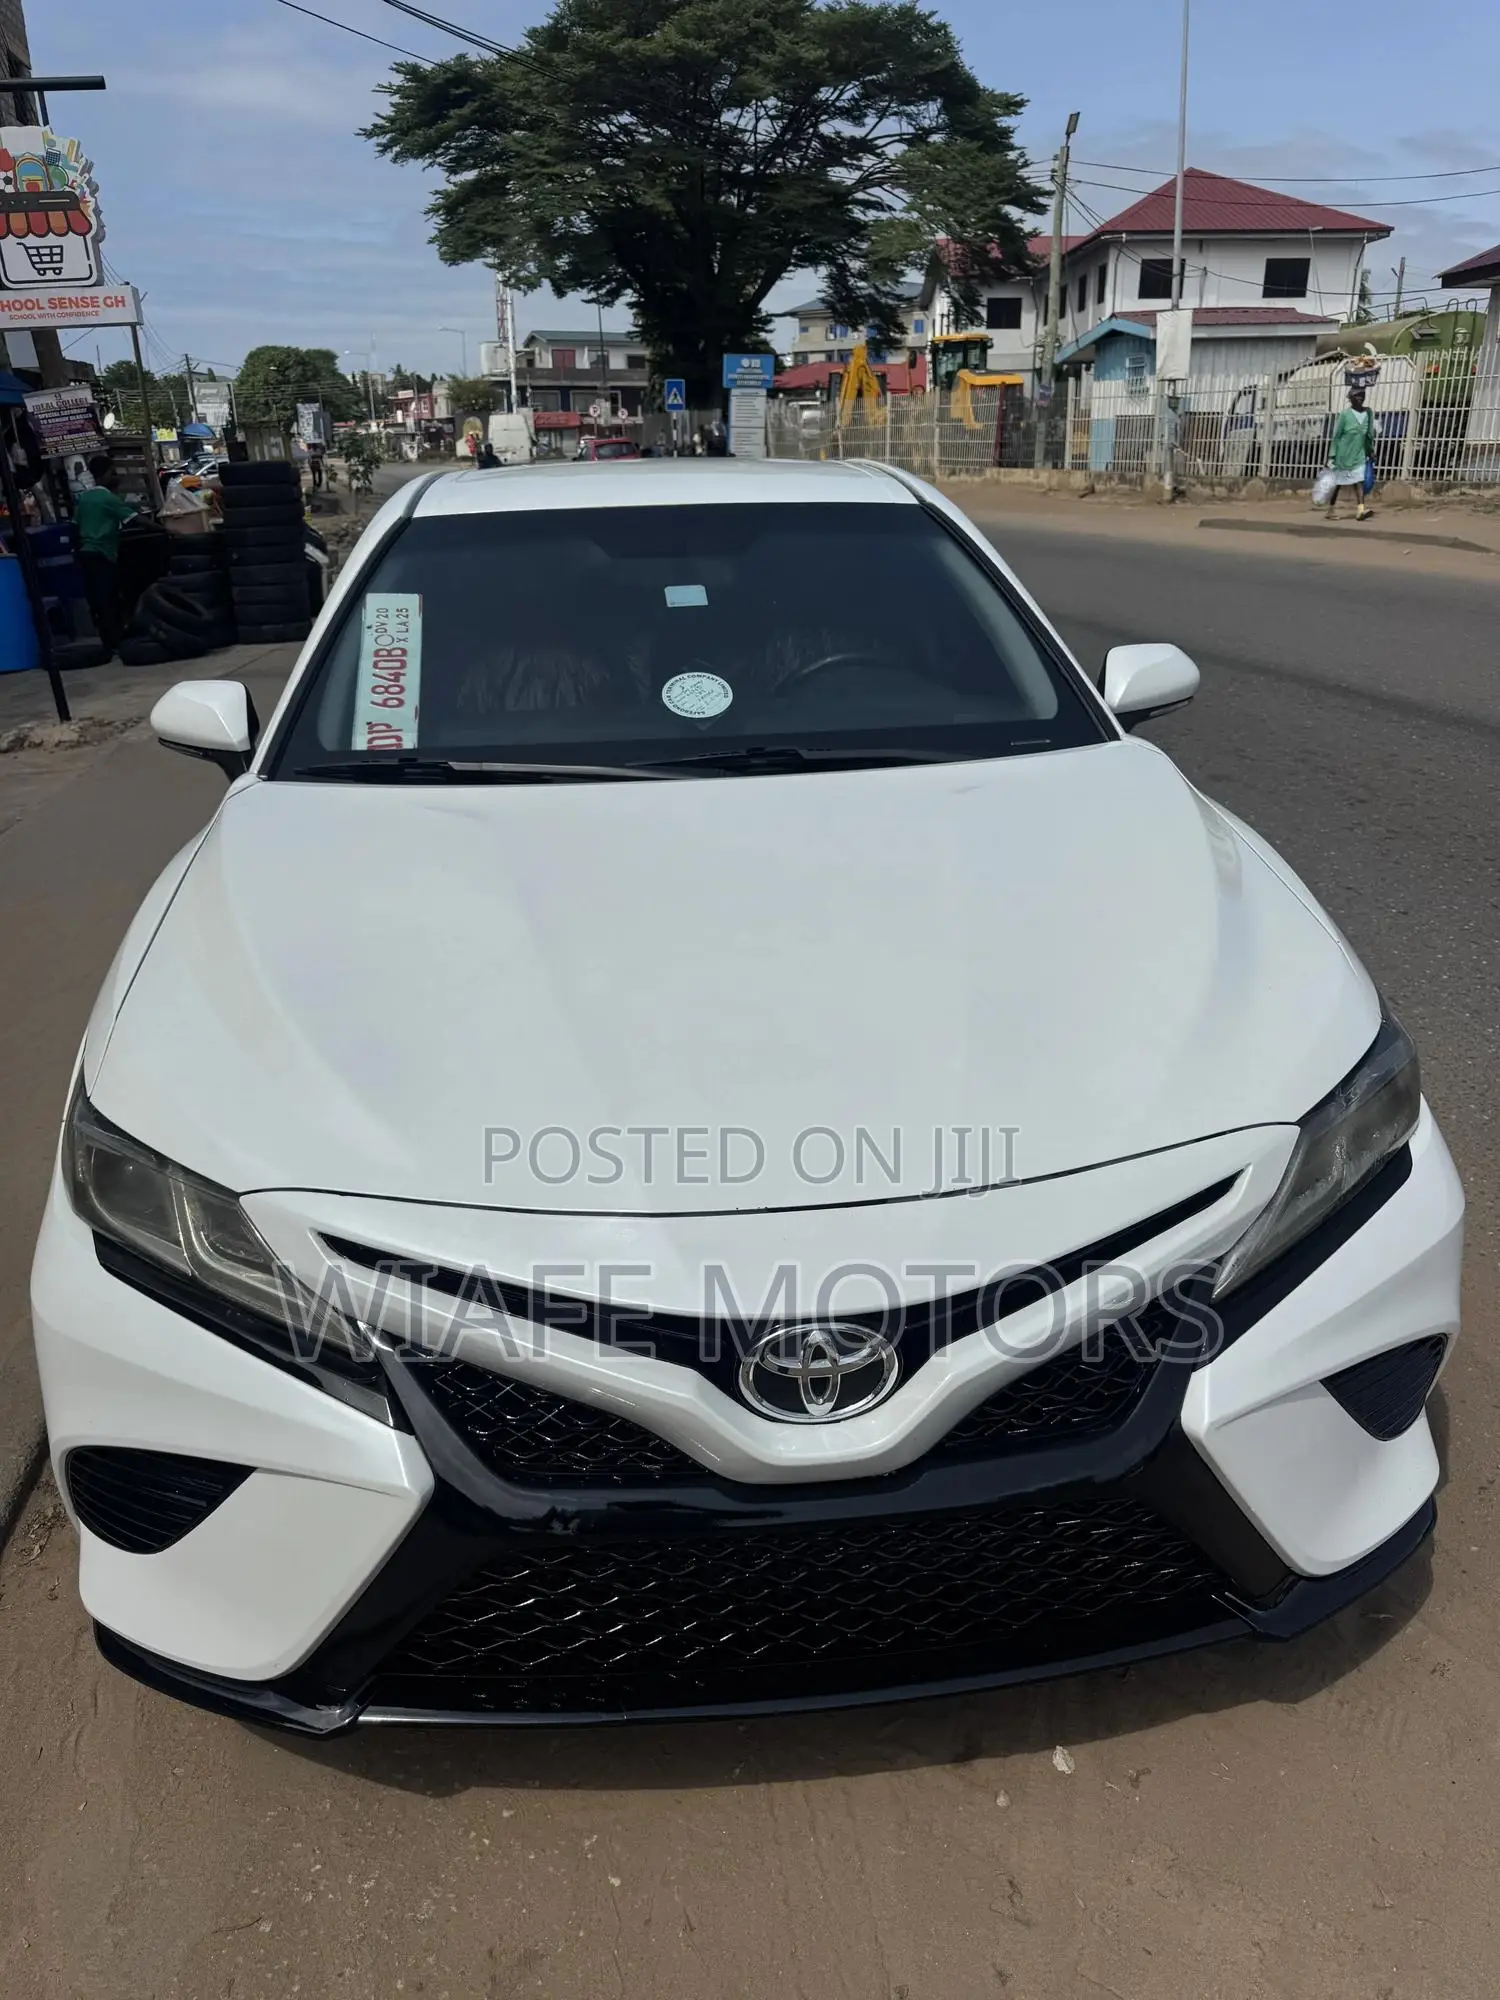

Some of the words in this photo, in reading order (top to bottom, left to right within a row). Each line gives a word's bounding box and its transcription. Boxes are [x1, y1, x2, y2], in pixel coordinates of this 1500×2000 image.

[48, 295, 100, 310] SENSE
[103, 295, 126, 308] GH
[38, 311, 56, 319] WITH
[56, 310, 100, 318] CONFIDENCE
[376, 607, 389, 620] 20
[396, 607, 409, 619] 25
[374, 622, 388, 634] DV
[396, 621, 409, 634] LA
[687, 674, 720, 683] COMPANY
